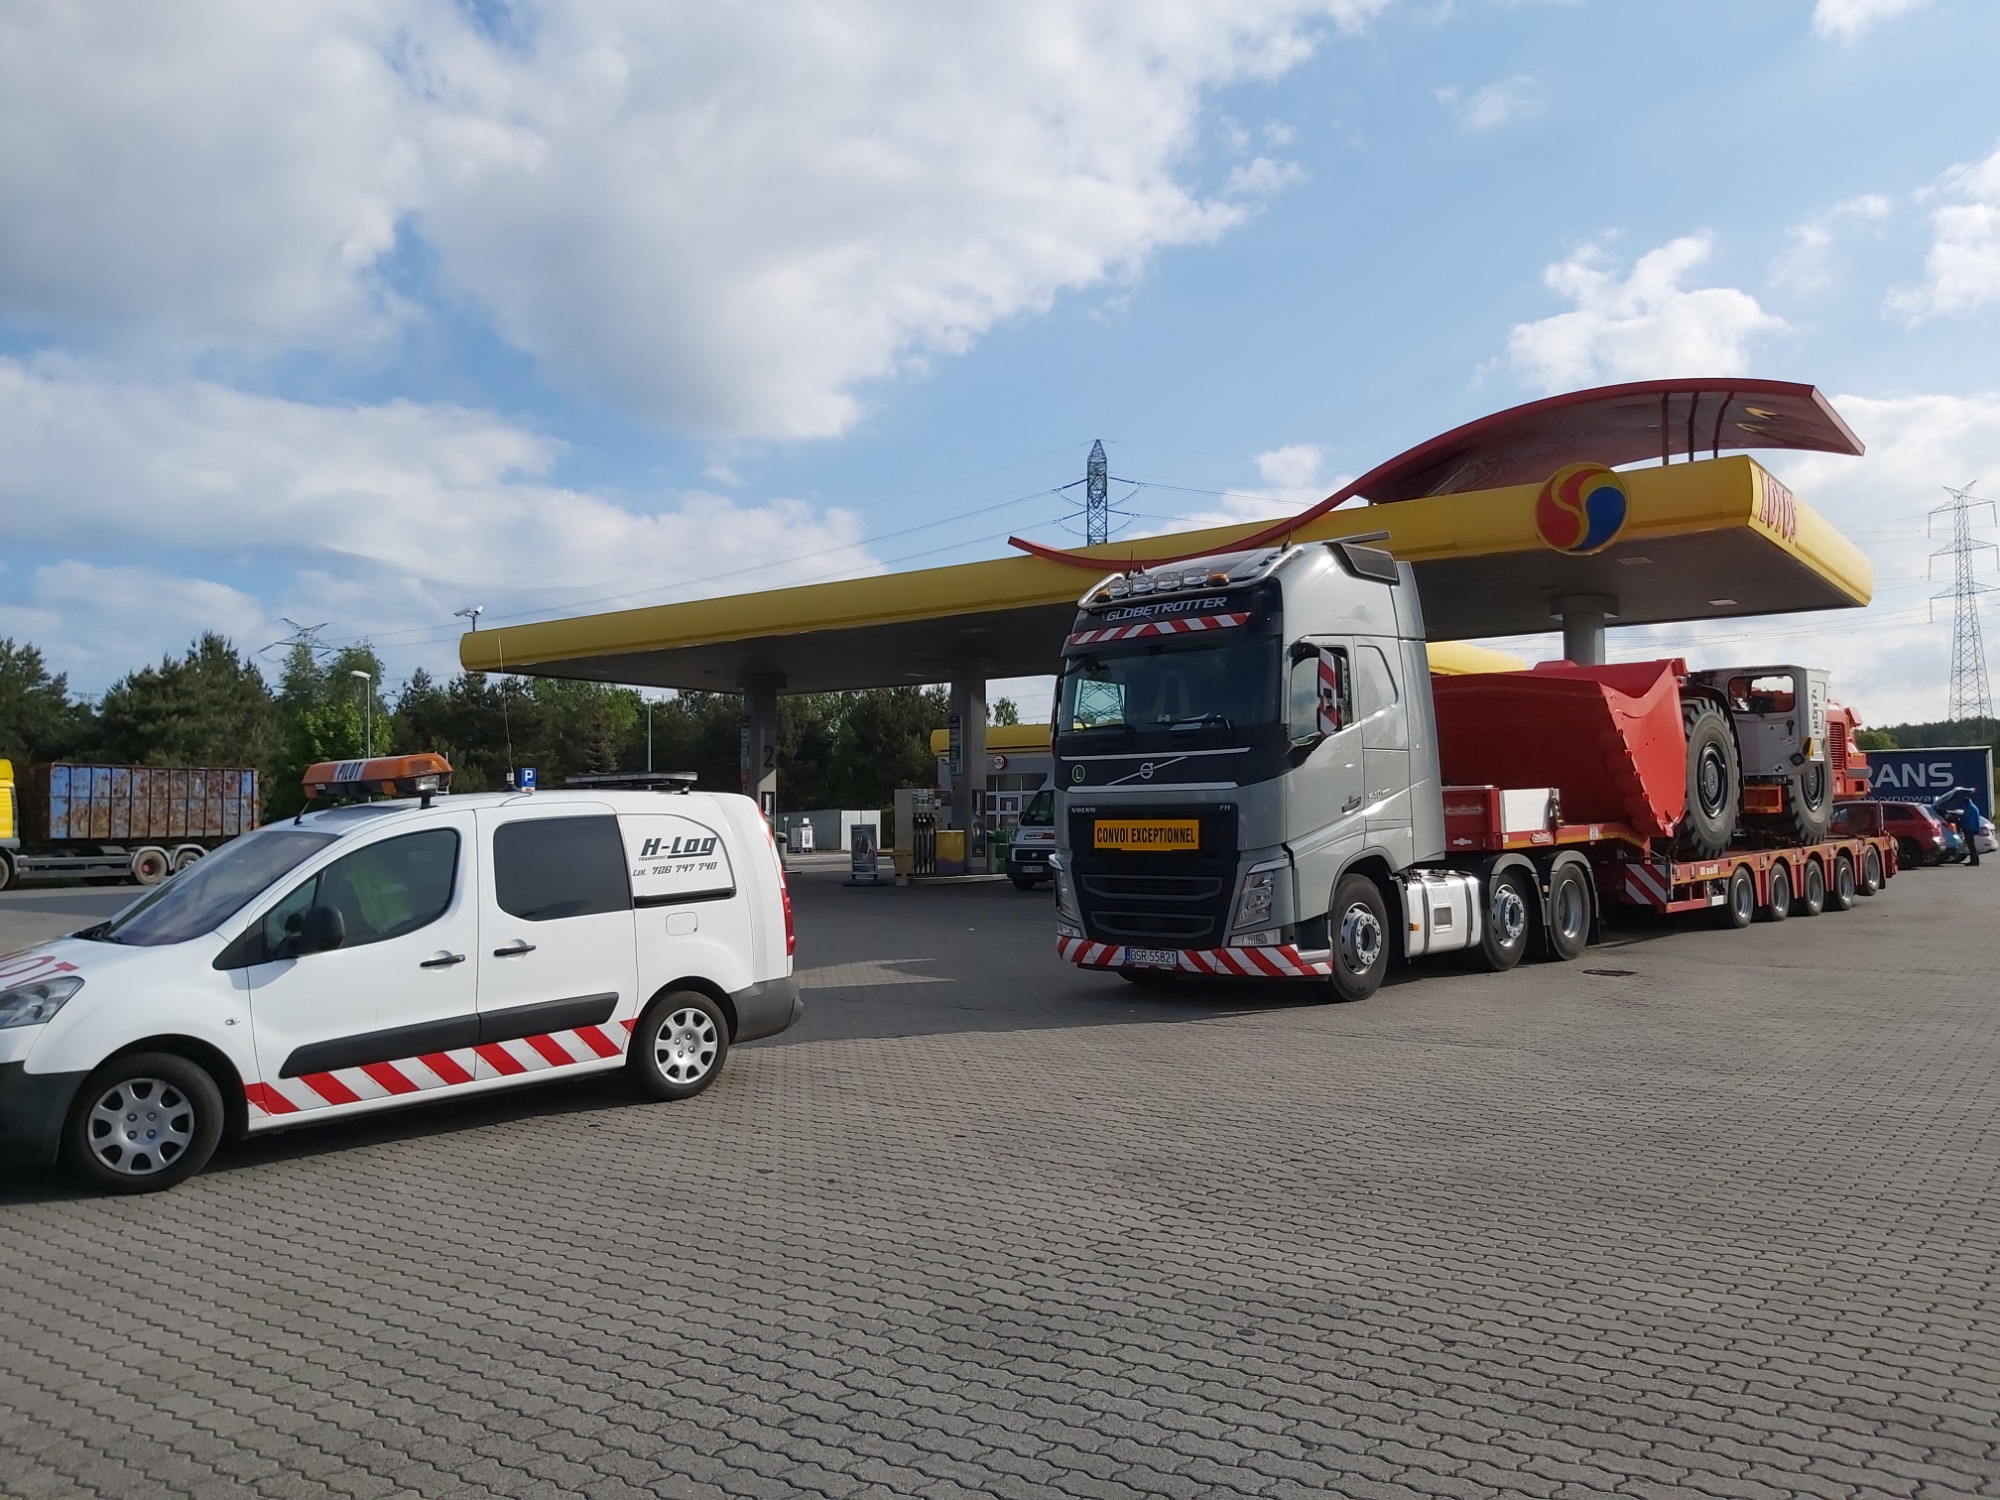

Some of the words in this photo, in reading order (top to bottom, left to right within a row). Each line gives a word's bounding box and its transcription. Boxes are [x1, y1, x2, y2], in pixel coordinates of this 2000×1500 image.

[1106, 596, 1227, 622] GLOBETROTTER
[763, 745, 774, 768] 2
[337, 761, 363, 780] PILOT
[524, 769, 533, 782] P
[1219, 804, 1231, 812] FH
[1096, 827, 1129, 844] CONVOI
[1131, 827, 1196, 844] EXCEPTIONNEL
[639, 854, 667, 862] TRANSPORT
[652, 865, 673, 876] 726
[676, 863, 695, 874] 747
[699, 861, 718, 872] 740
[1130, 948, 1147, 962] DSR
[1149, 950, 1176, 964] 55821
